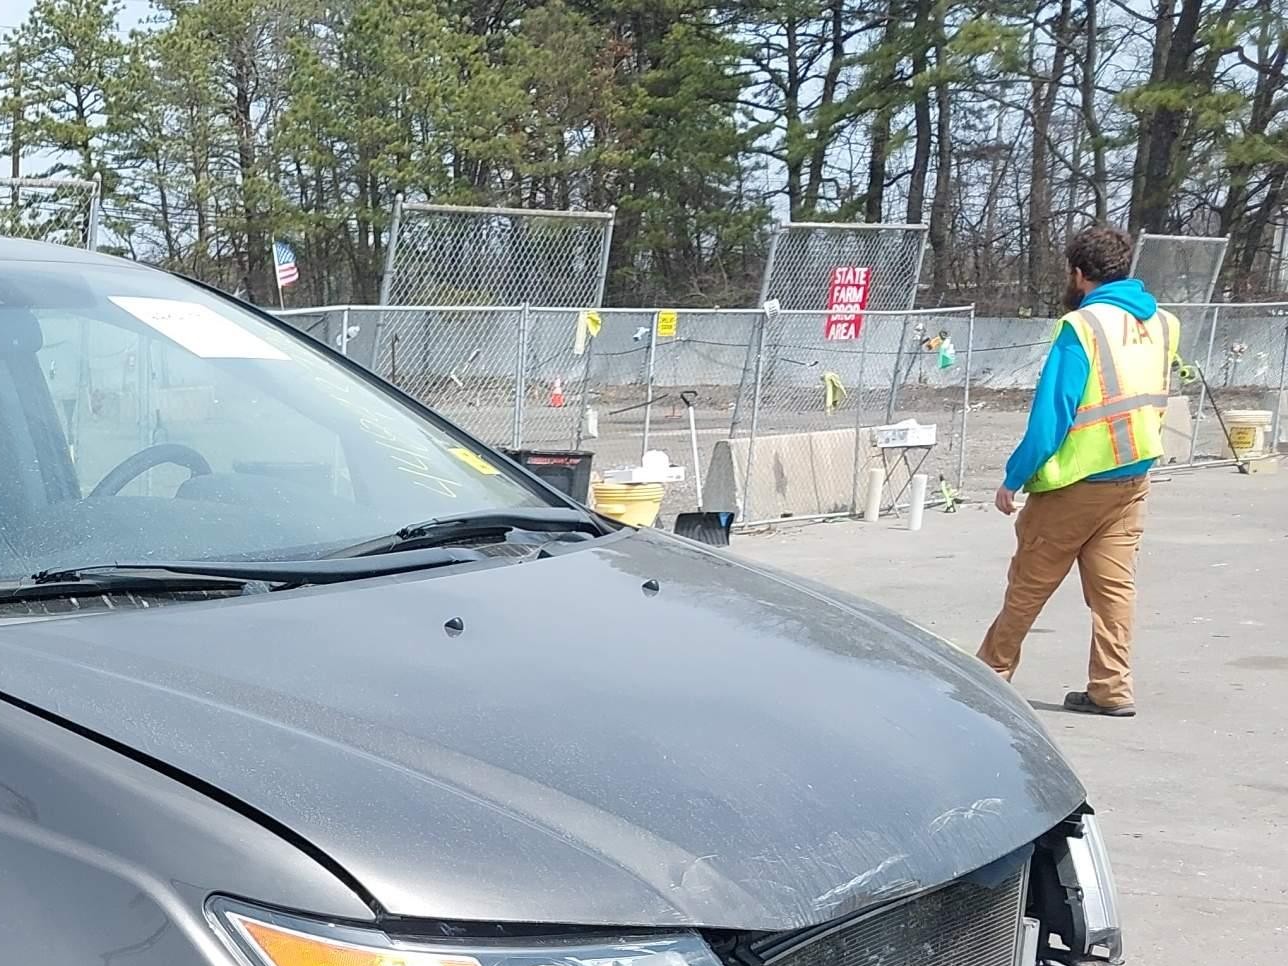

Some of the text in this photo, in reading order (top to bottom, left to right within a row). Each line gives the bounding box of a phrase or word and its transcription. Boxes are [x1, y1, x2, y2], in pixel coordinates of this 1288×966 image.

[834, 267, 868, 285] STATE
[833, 286, 865, 303] FARM
[828, 323, 856, 340] AREA
